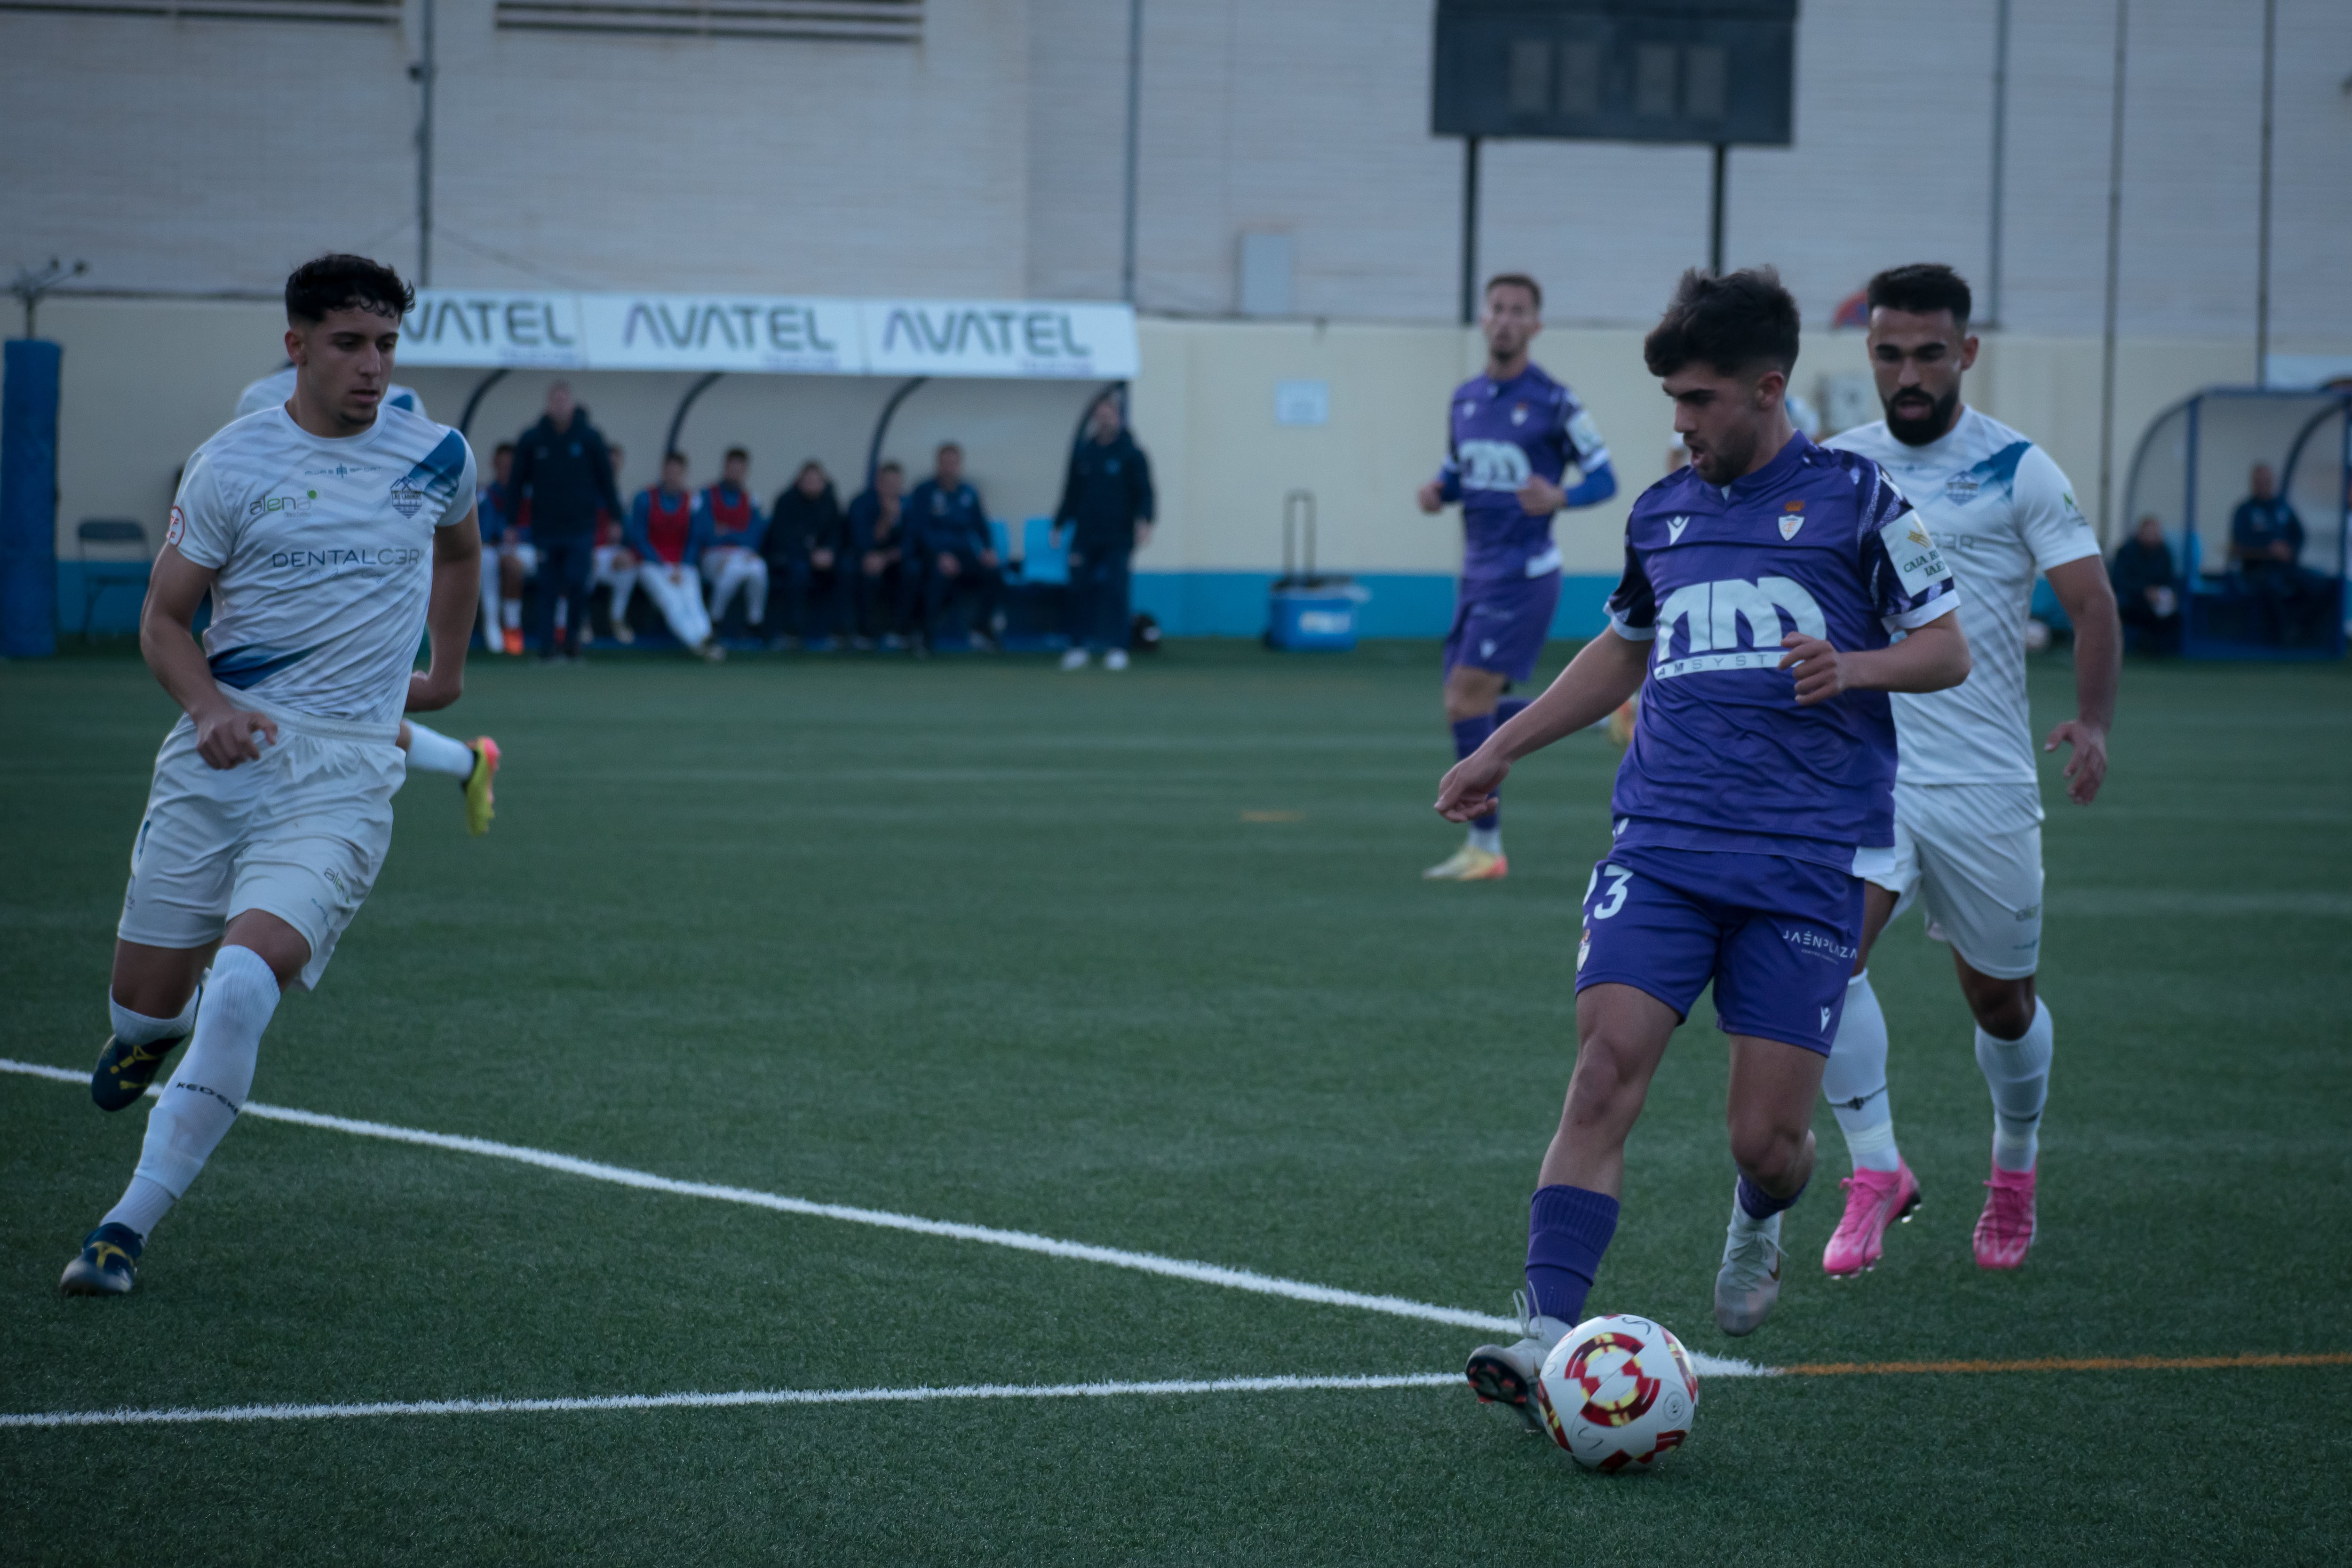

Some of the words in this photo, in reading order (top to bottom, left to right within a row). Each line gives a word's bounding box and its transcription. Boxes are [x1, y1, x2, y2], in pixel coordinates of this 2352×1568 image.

[401, 298, 575, 347] VATEL
[622, 302, 837, 352] AVATEL
[882, 307, 1091, 357] AVATEL
[1924, 560, 1945, 577] JAÉ
